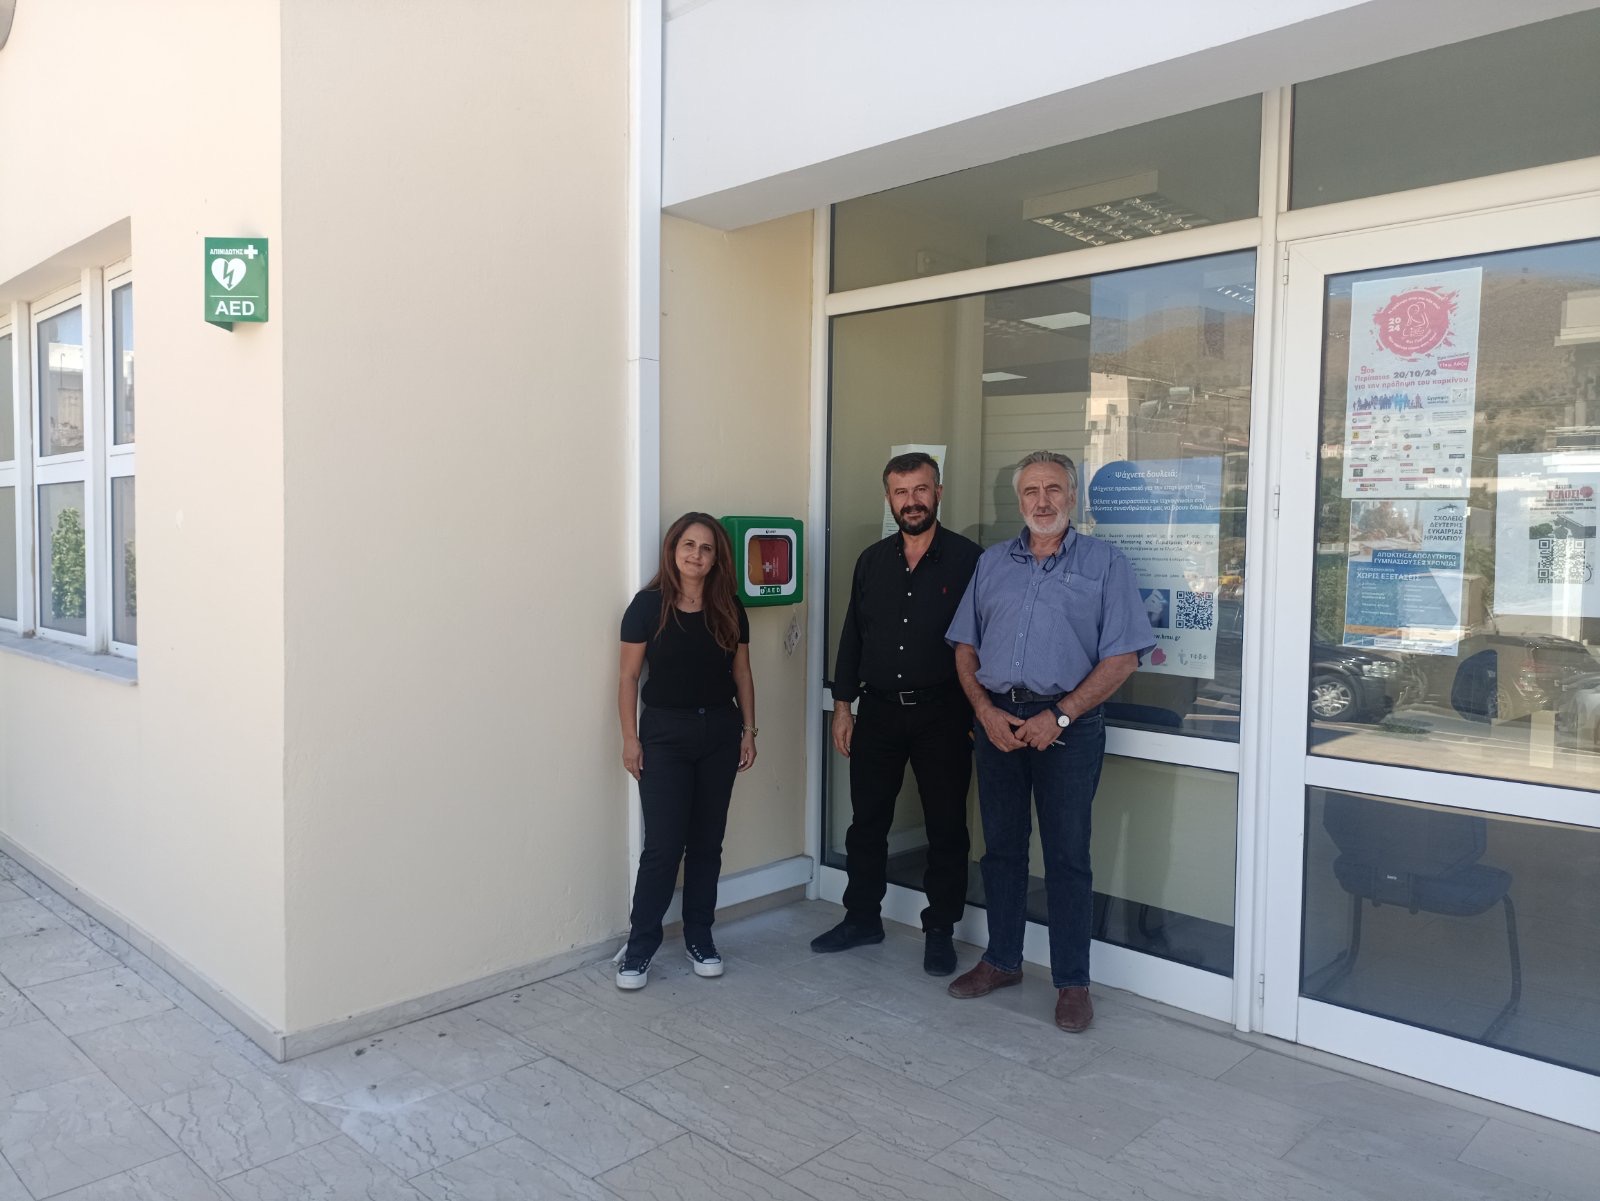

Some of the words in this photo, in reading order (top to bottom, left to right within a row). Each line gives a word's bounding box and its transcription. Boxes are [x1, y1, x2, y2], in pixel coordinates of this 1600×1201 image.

[214, 300, 255, 316] AED
[1393, 369, 1437, 379] 20/10/24
[1115, 470, 1145, 479] Ψάχνετε
[1146, 469, 1178, 479] δουλειά;
[1376, 551, 1412, 559] ΑΠΟΚΤΗΣΕ
[1412, 552, 1457, 560] ΑΠΟΛΥΤΗΡΙΟ
